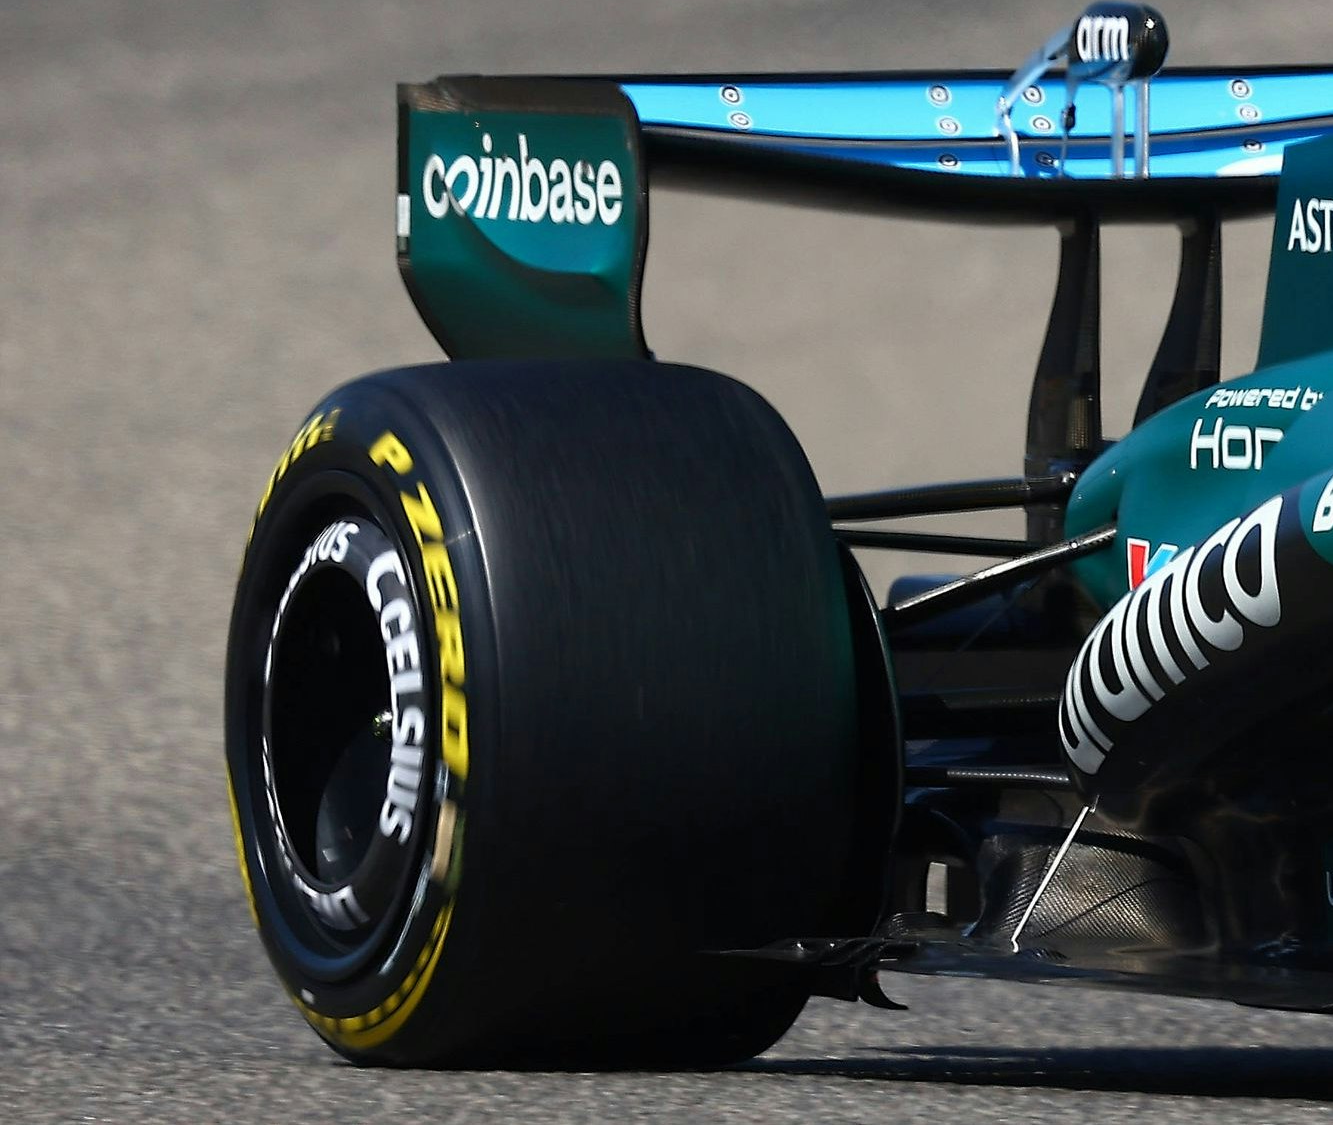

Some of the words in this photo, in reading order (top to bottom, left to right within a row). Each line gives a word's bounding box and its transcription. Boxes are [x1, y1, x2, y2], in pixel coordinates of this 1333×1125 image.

[1077, 16, 1129, 62] arm
[423, 133, 623, 225] coinbase
[1205, 386, 1301, 409] Powered
[368, 430, 415, 476] P
[400, 481, 470, 780] ZERO
